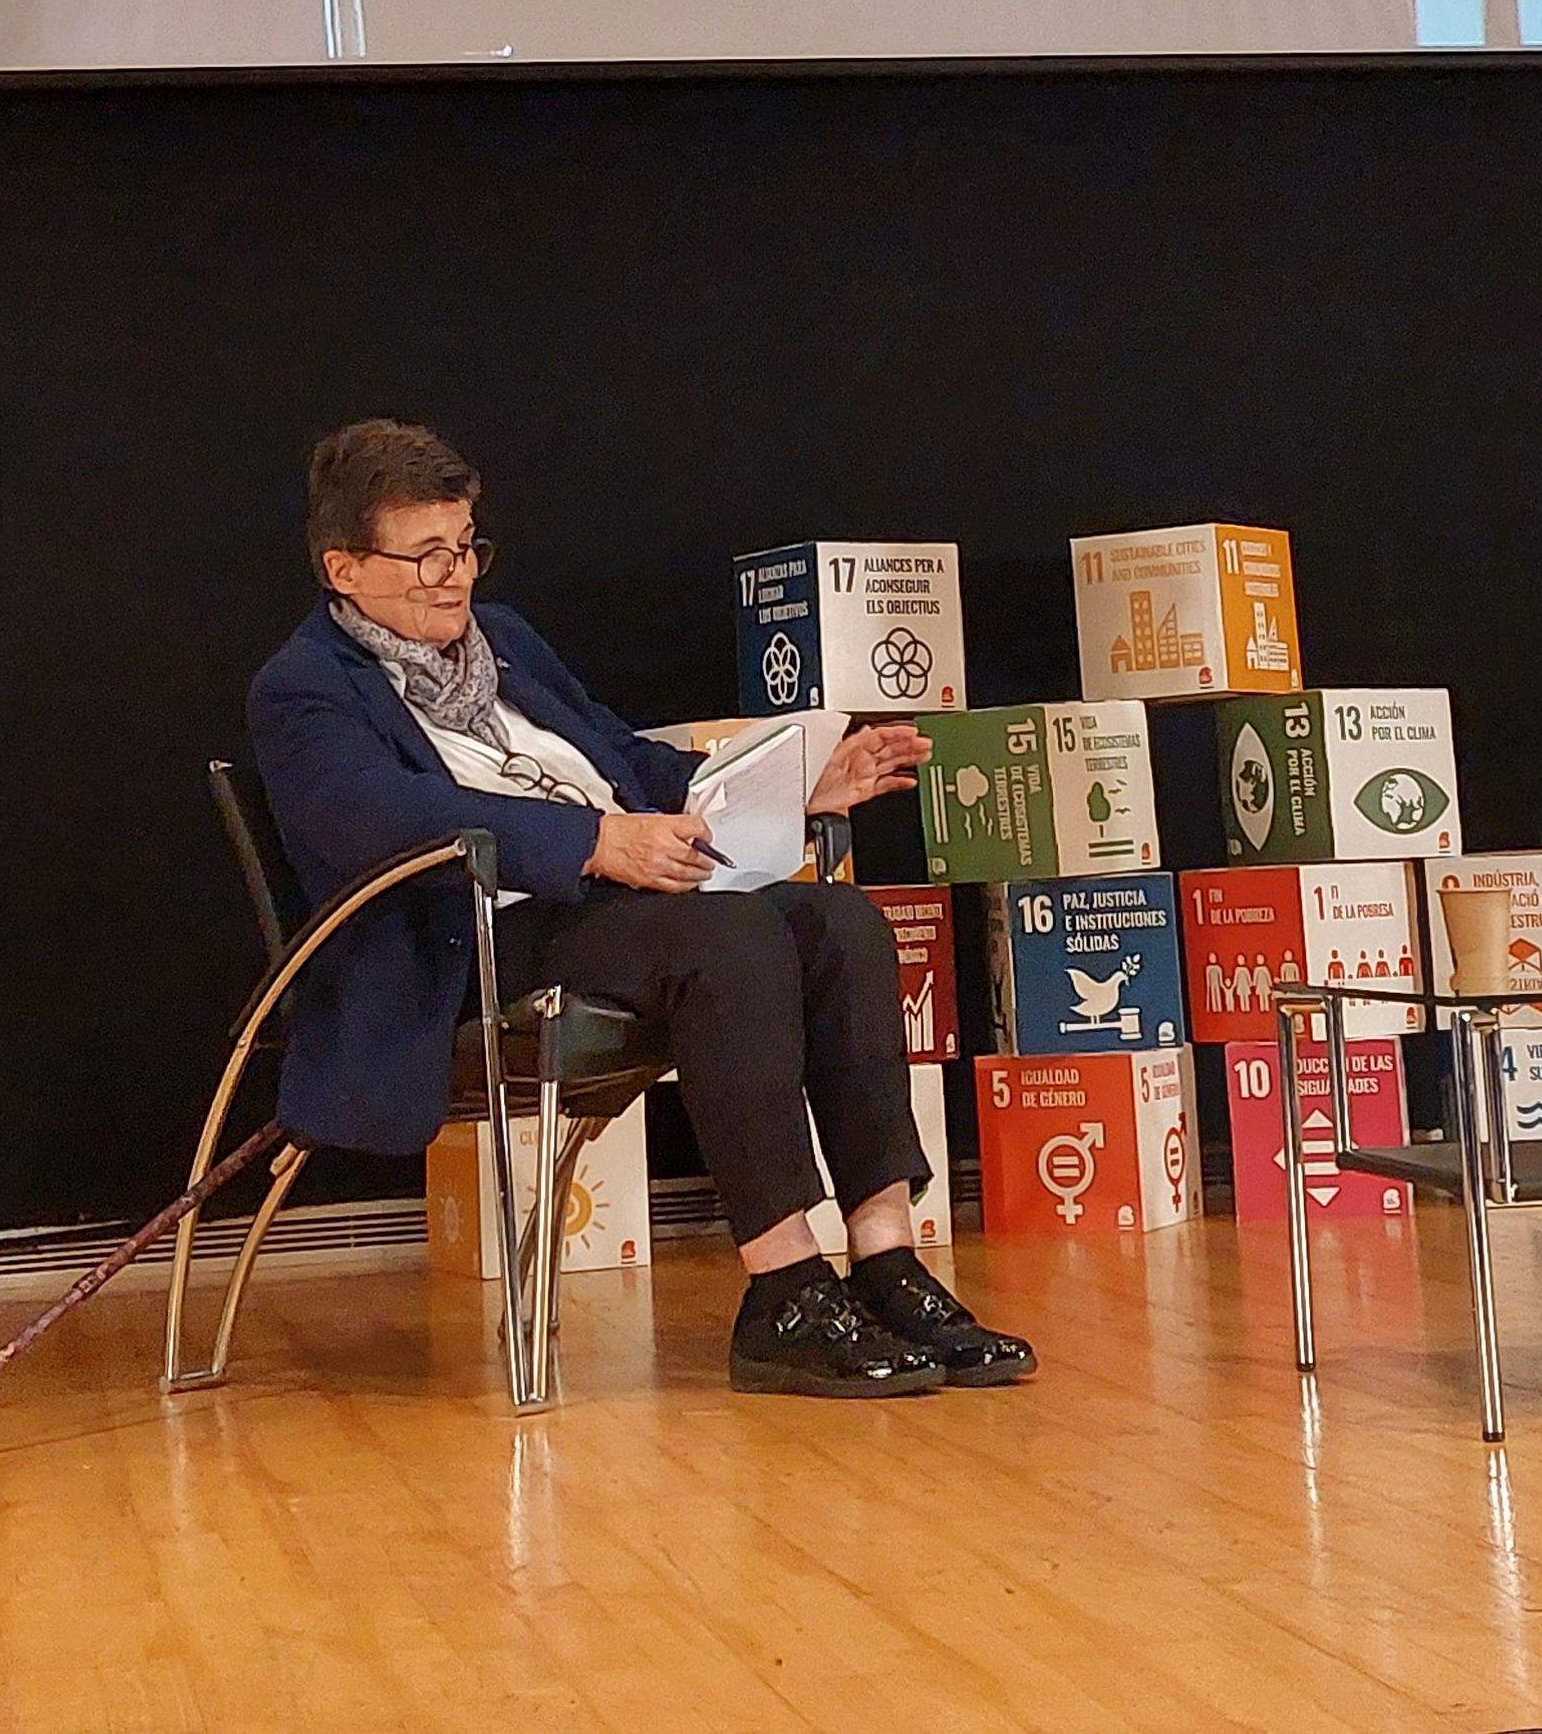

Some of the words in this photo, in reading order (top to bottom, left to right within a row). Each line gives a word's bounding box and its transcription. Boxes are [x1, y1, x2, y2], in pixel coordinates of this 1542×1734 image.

[864, 558, 912, 573] ALIANCES
[914, 558, 935, 573] PER
[936, 559, 945, 573] A
[1082, 550, 1105, 585] 11
[1223, 539, 1240, 574] 11
[740, 569, 755, 606] 17
[829, 557, 857, 594] 17
[864, 579, 931, 594] ACONSEGUIR
[866, 600, 884, 614] ELS
[886, 599, 941, 615] OBJECTIUS
[1284, 701, 1310, 740] 13
[1335, 705, 1363, 741] 13
[1370, 701, 1406, 720] ACCIÓN
[1007, 718, 1038, 755] 15
[1053, 716, 1076, 753] 15
[1371, 726, 1392, 741] POR
[1408, 725, 1436, 740] CLIMA
[1300, 748, 1317, 797] ACCIÓN
[1472, 869, 1540, 888] INDÚSTRIA,
[1018, 894, 1054, 934] 16
[1063, 892, 1089, 910] PAZ,
[1091, 889, 1147, 908] JUSTICIA
[1192, 888, 1205, 925] 1
[1314, 885, 1326, 920] 1
[1332, 905, 1344, 920] DE
[1345, 905, 1357, 919] LA
[1065, 915, 1072, 931] E
[1075, 910, 1167, 930] INSTITUCIONES
[1065, 934, 1120, 953] SÓLIDAS
[1020, 1068, 1080, 1086] IGUALDAD
[1234, 1059, 1271, 1098] 10
[1351, 1057, 1367, 1073] DE
[1370, 1054, 1394, 1072] LAS
[1501, 1046, 1518, 1081] 4
[992, 1070, 1010, 1108] 5
[1022, 1091, 1037, 1108] DE
[1039, 1087, 1087, 1108] GÉNERO
[1140, 1066, 1151, 1104] 5
